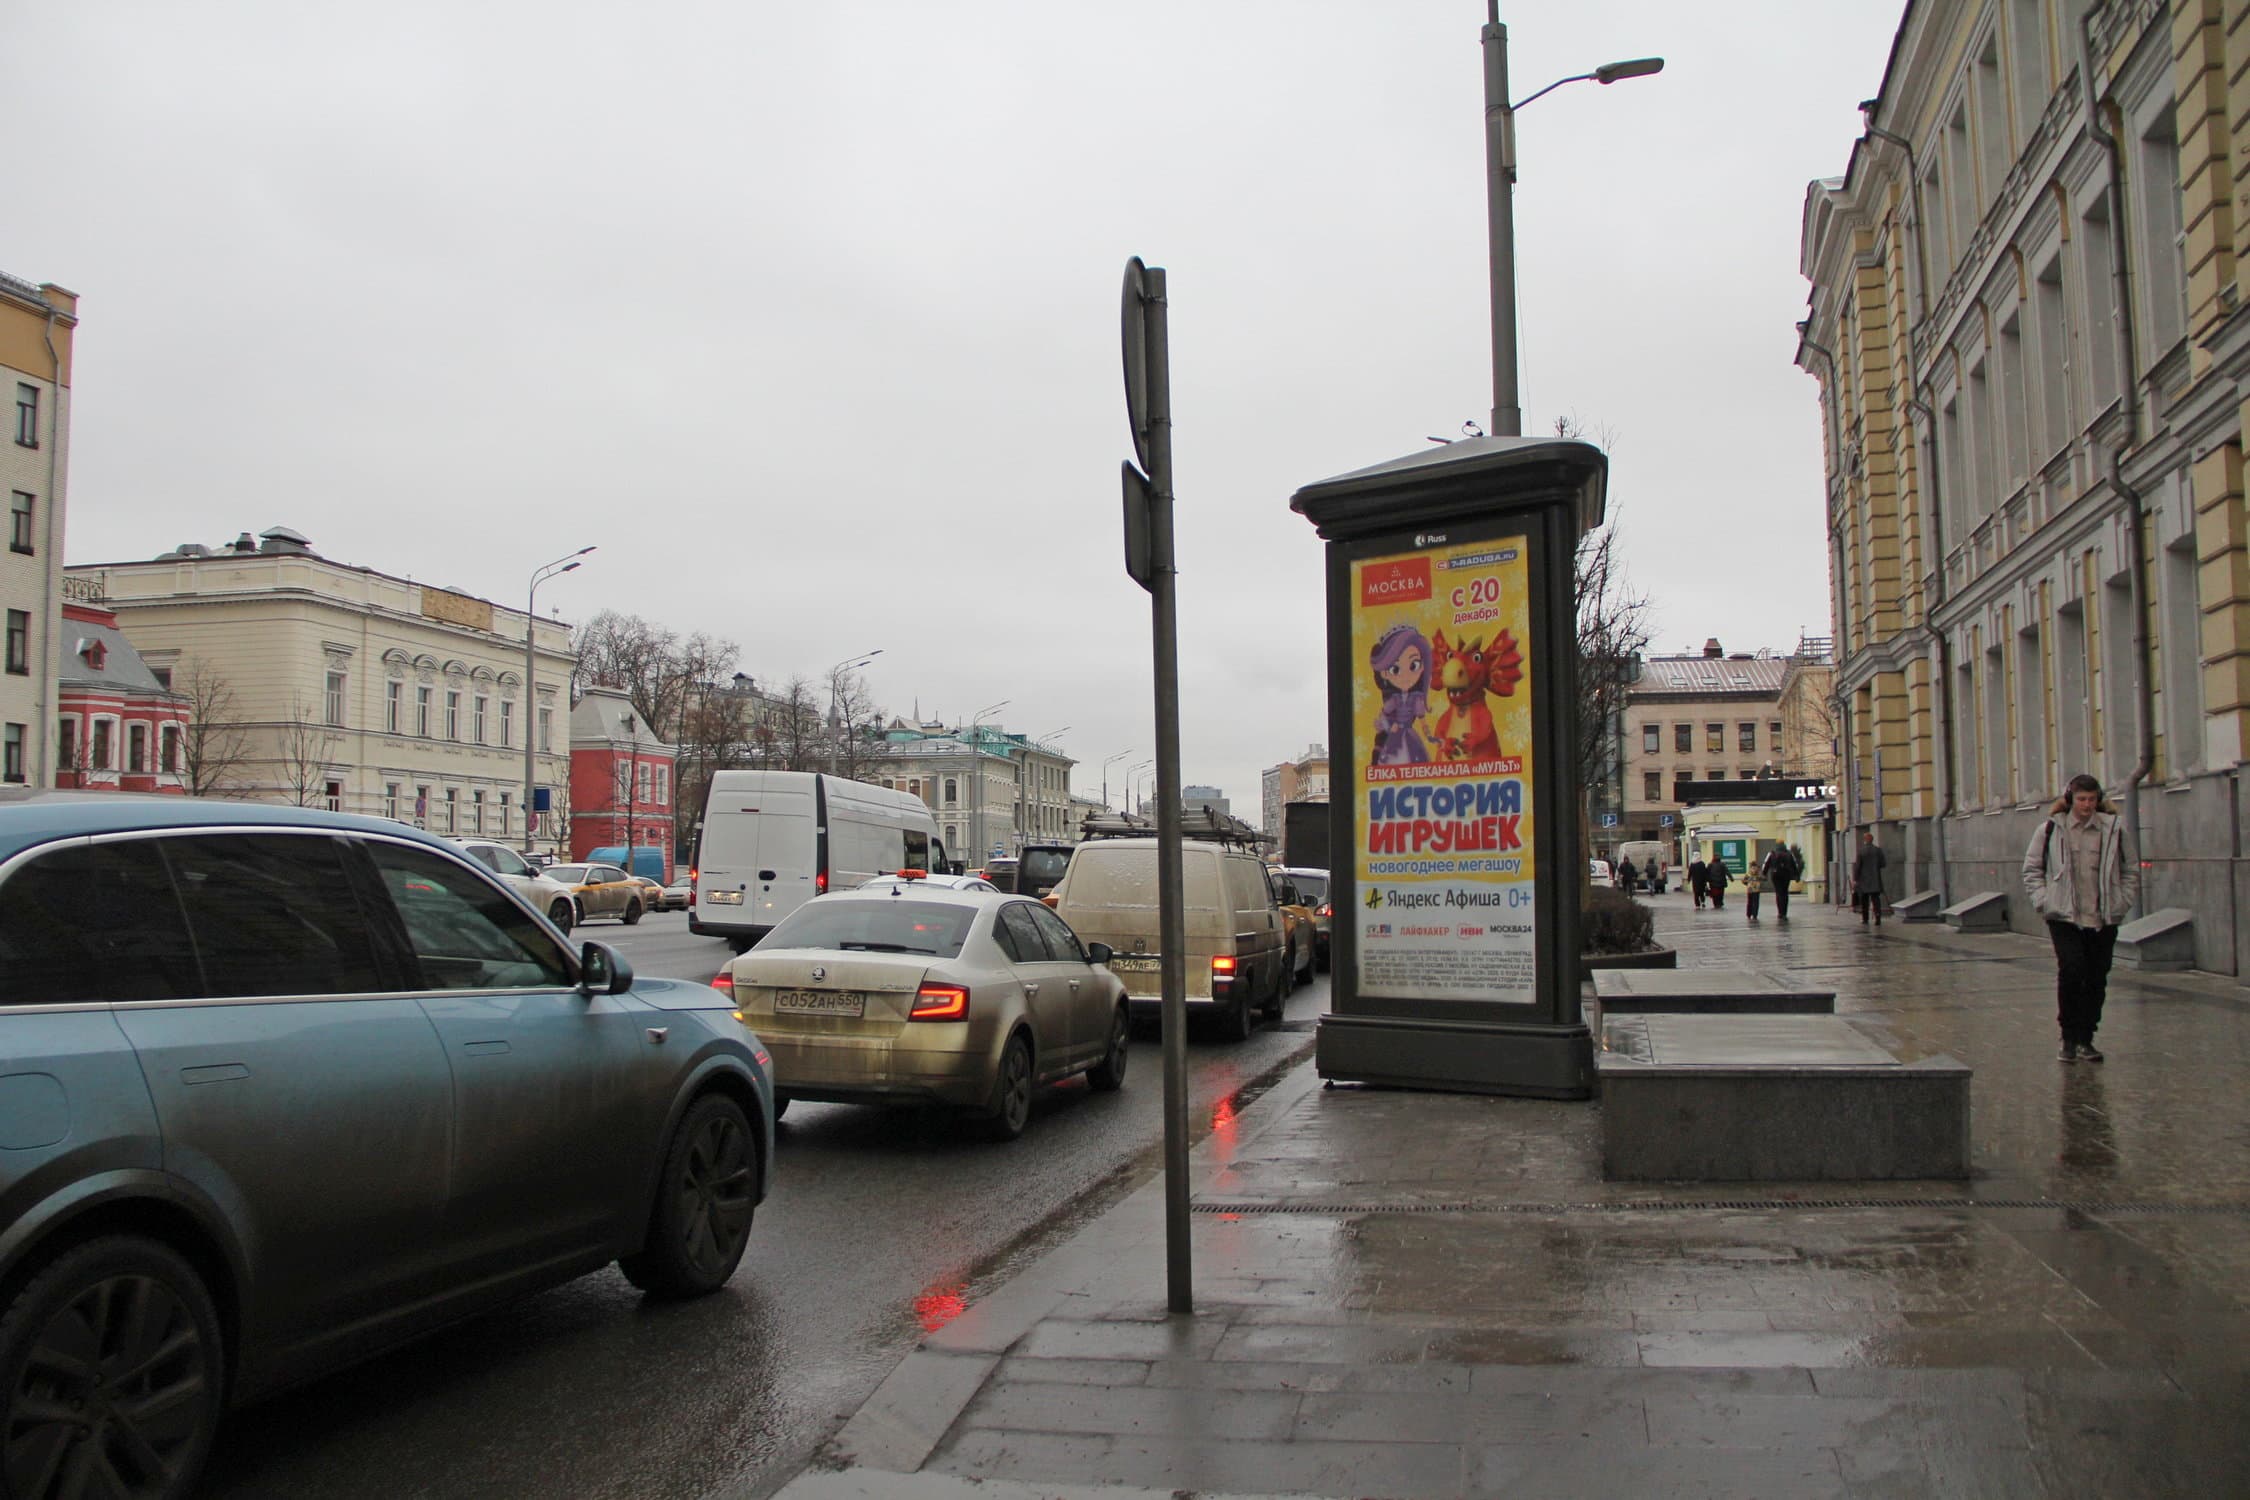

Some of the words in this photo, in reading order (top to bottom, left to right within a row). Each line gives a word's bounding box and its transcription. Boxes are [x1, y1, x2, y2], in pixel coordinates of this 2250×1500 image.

[1428, 535, 1447, 543] Russ
[1368, 577, 1424, 594] МОСКВА
[1471, 578, 1500, 604] 20
[1454, 607, 1499, 624] декабря
[1367, 767, 1397, 780] ЁЛКА
[1400, 764, 1470, 778] ТЕЛЕКАНАЛА
[1472, 759, 1521, 775] «МУЛЬТ»
[1369, 780, 1521, 820] ИСТОРИЯ
[1368, 814, 1522, 854] ИГРУШЕК
[1369, 861, 1454, 875] новогоднее
[1458, 858, 1520, 875] мегашоу
[1388, 889, 1440, 909] Яндекс
[1445, 888, 1500, 910] Афиша
[1508, 887, 1531, 909] 0+
[1400, 924, 1450, 937] ЛАЙФХАКЕР
